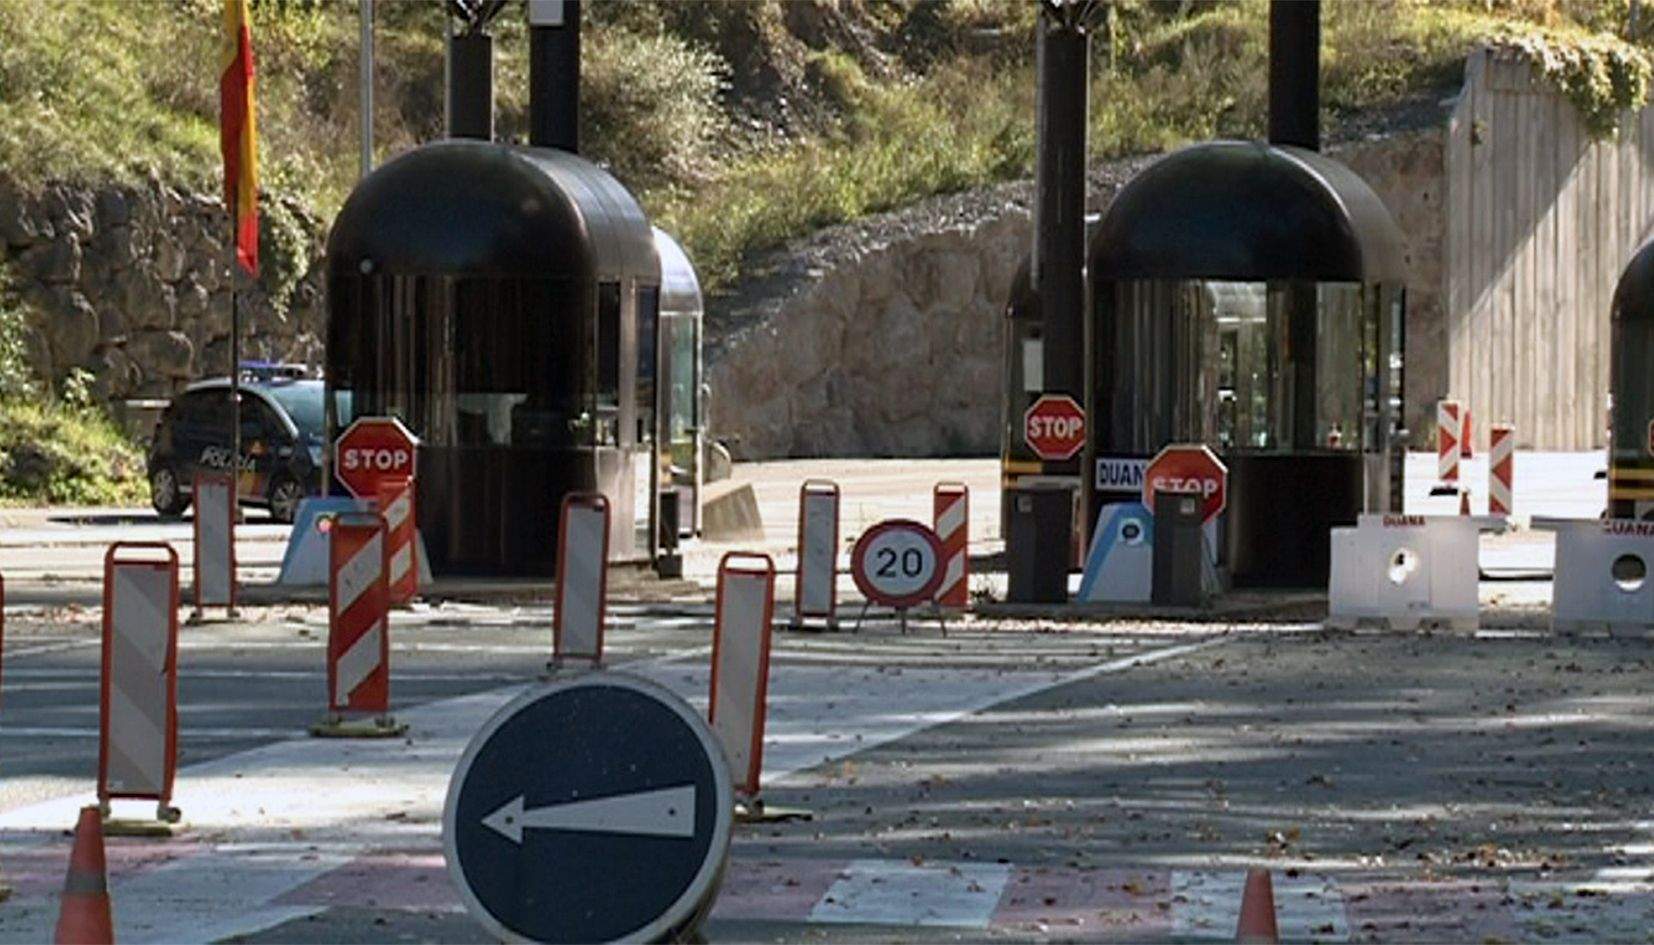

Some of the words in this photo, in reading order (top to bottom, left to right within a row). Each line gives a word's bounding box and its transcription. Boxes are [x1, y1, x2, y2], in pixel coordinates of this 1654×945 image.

[1029, 416, 1083, 439] STOP
[343, 449, 409, 470] STOP
[1152, 477, 1218, 499] STOP
[876, 547, 923, 578] 20
